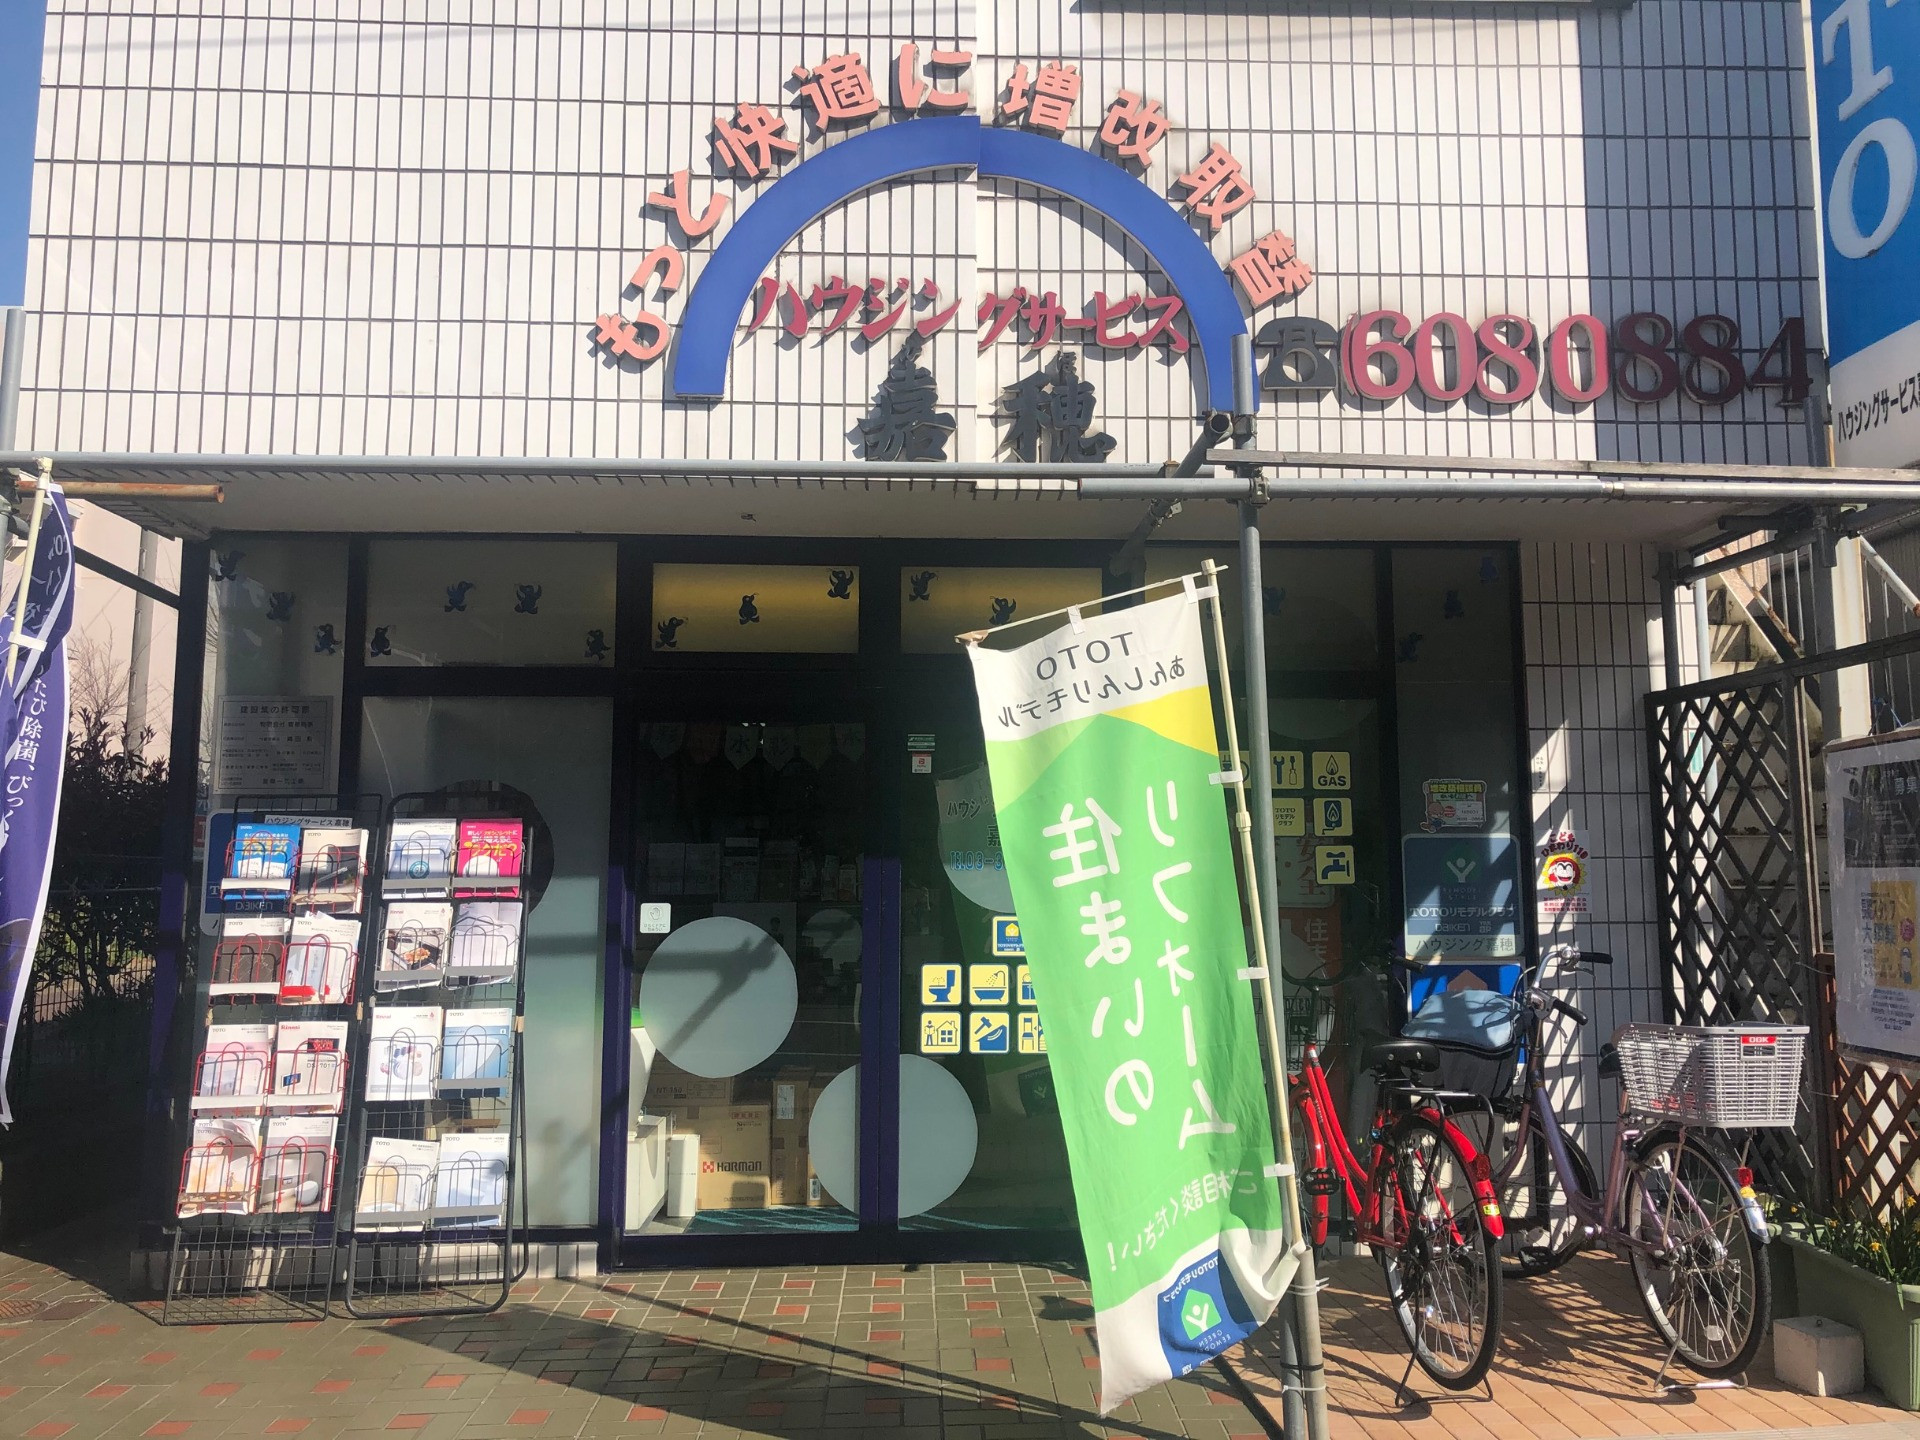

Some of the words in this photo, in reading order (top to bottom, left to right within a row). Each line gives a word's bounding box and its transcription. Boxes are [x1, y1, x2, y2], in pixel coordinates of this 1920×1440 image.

[747, 274, 1190, 355] ハウジングサービス
[1318, 775, 1347, 787] GAS
[950, 851, 1006, 871] TEL03-3
[1410, 904, 1516, 917] TOTOリモデルクラブ
[1416, 937, 1514, 951] ハウジング嘉穂
